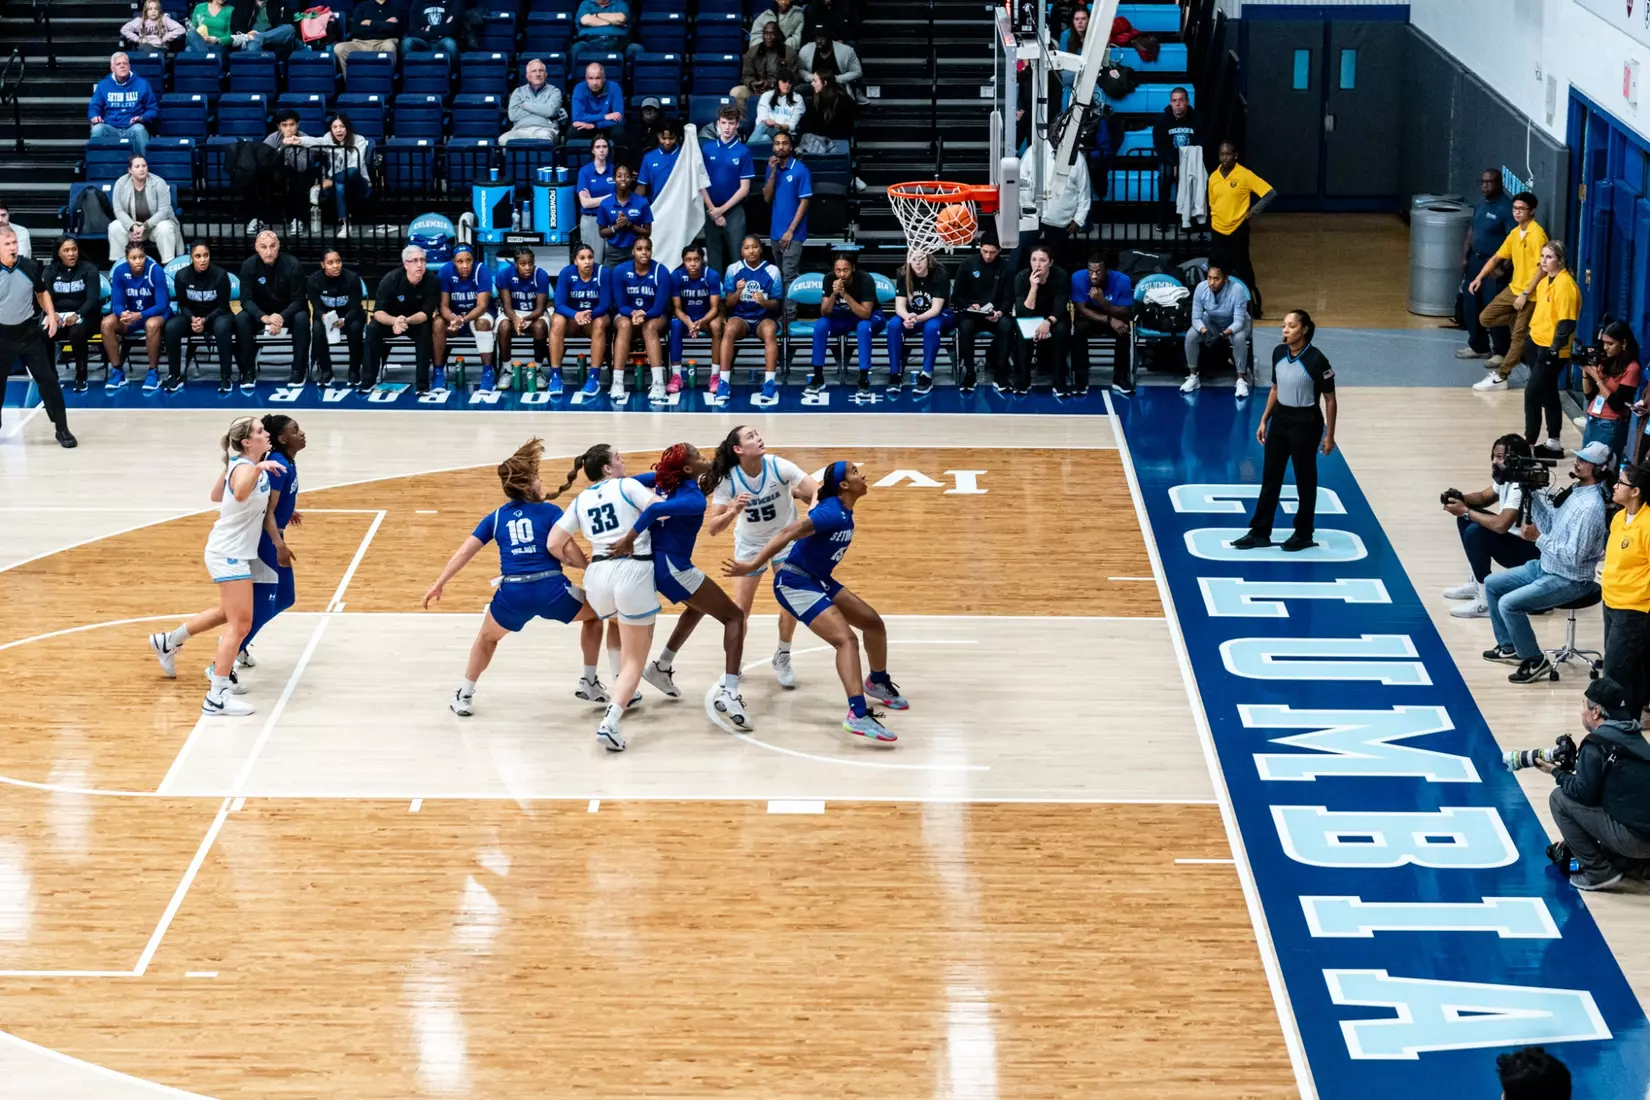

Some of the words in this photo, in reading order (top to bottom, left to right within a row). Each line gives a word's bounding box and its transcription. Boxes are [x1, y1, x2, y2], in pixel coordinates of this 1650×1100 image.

[548, 189, 557, 229] POWERADE
[413, 219, 449, 230] COLUMBIA
[519, 301, 534, 311] 21
[587, 502, 620, 536] 33
[744, 503, 777, 523] 35
[505, 517, 535, 547] 10
[1167, 483, 1613, 1060] COLUMBIA
